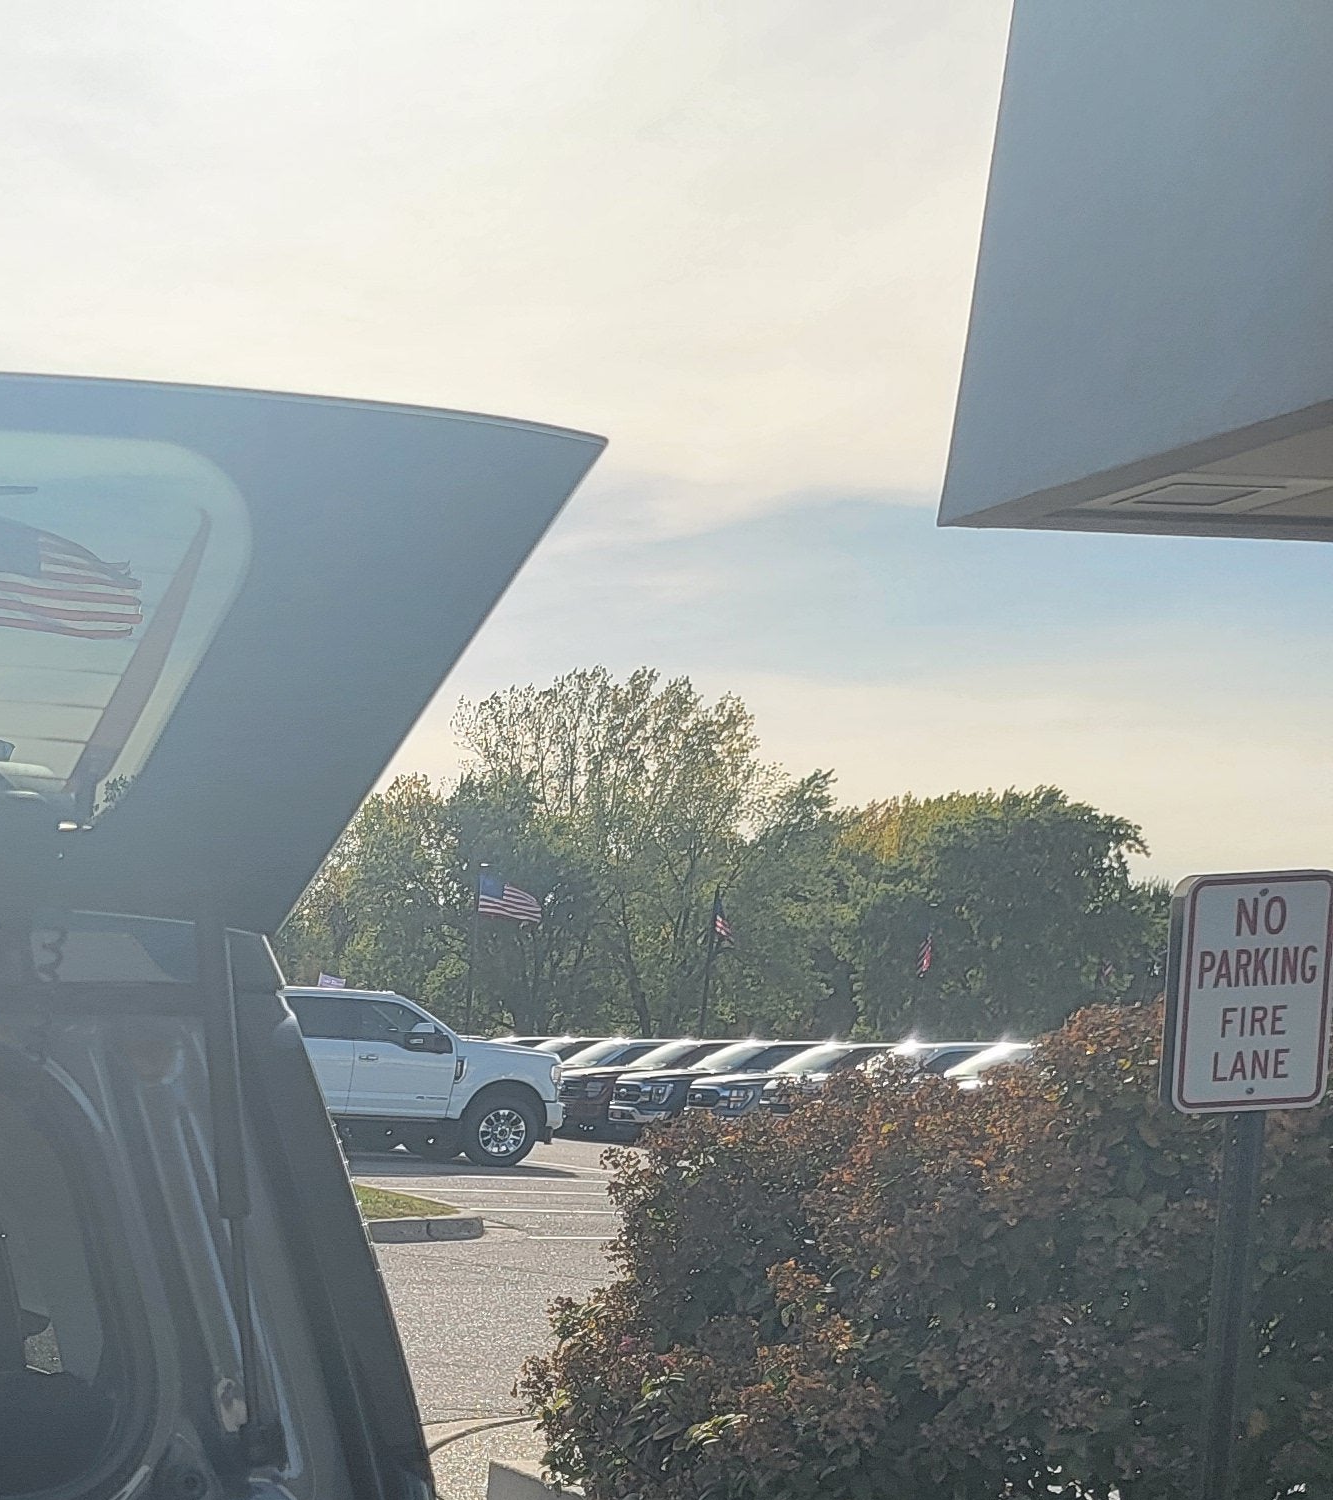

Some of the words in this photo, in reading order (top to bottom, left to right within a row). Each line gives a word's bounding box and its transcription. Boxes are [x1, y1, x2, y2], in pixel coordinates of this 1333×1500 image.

[1235, 895, 1287, 937] NO
[1198, 945, 1317, 990] PARKING
[1220, 1005, 1288, 1038] FIRE
[1211, 1048, 1290, 1082] LANE
